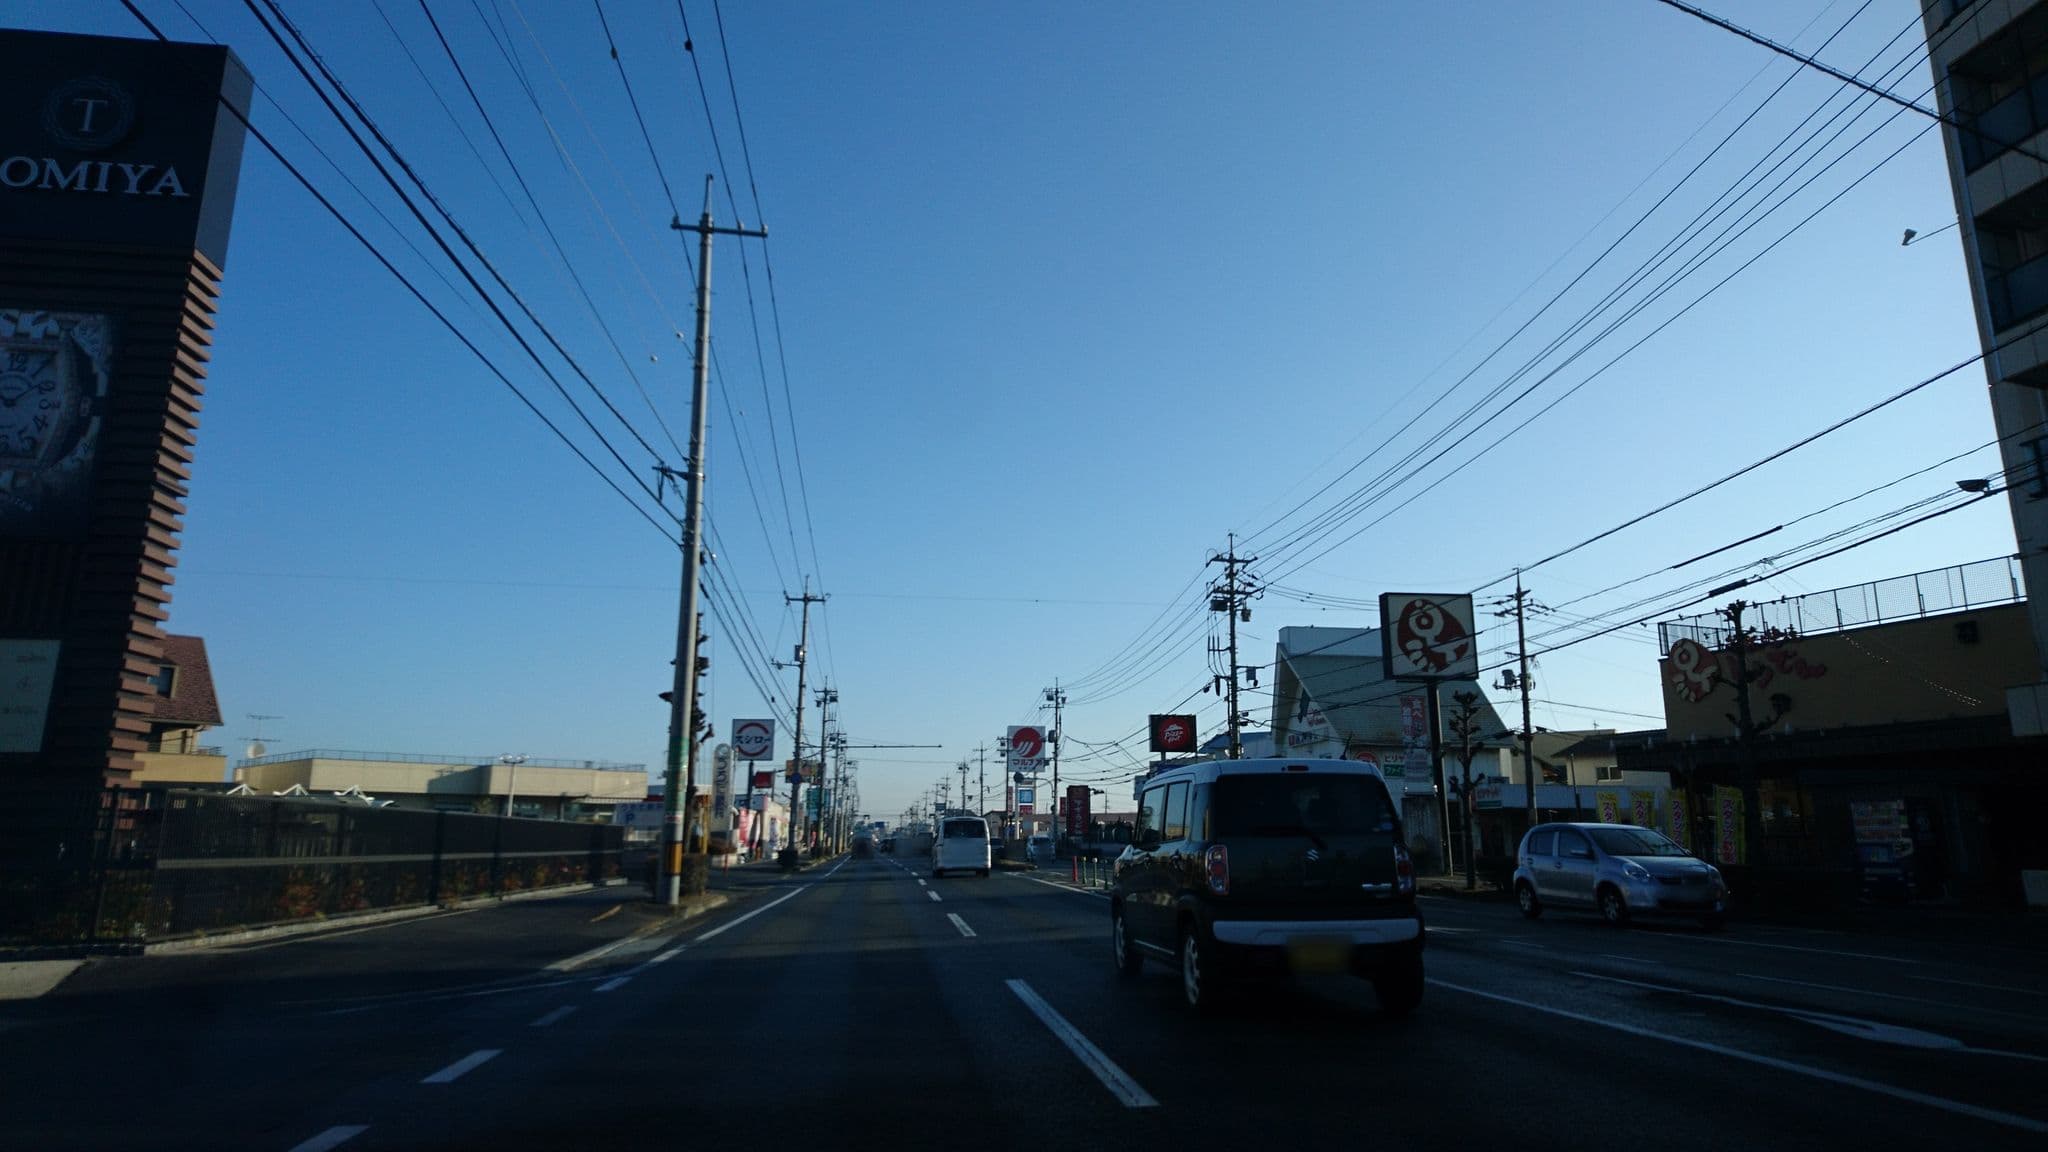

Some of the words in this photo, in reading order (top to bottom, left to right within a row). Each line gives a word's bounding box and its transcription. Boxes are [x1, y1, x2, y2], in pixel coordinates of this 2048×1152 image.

[73, 98, 110, 134] T
[735, 735, 771, 745] スシロー
